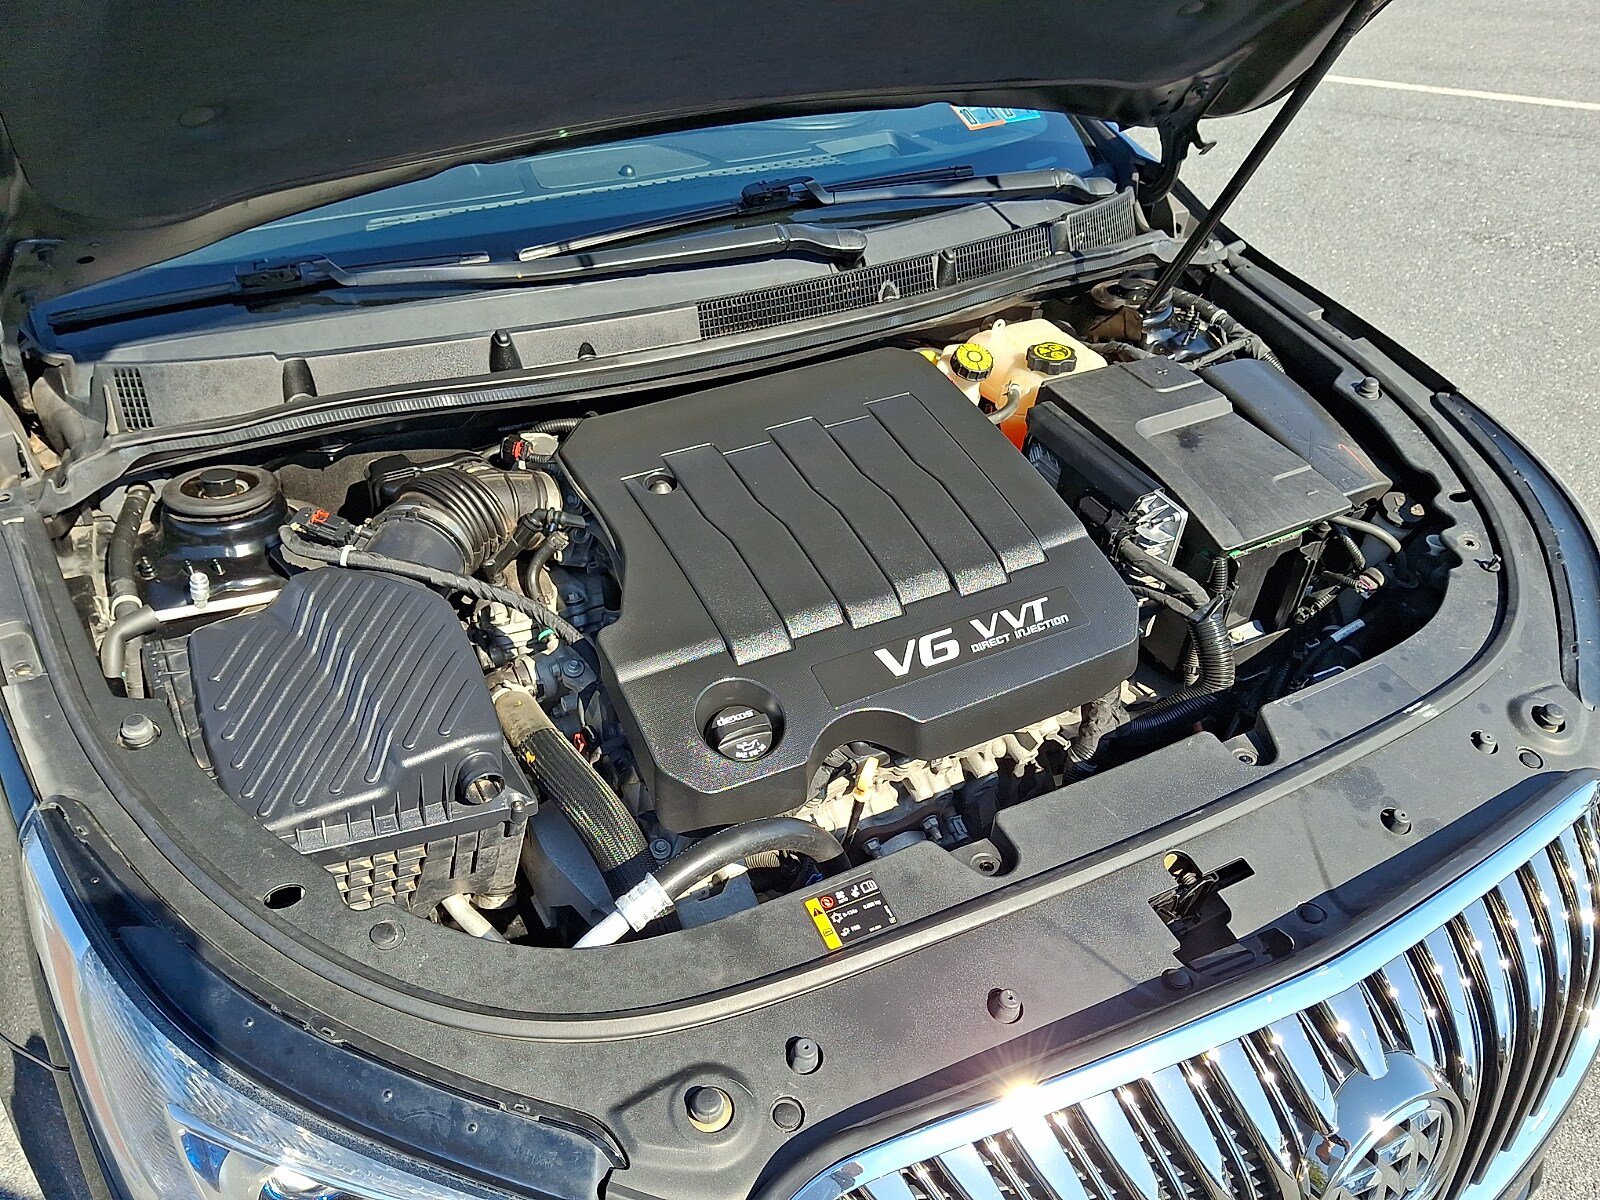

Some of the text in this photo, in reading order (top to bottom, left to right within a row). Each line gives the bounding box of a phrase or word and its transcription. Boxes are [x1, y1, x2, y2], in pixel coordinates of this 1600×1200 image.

[873, 596, 1049, 677] V6 VVT
[970, 613, 1070, 653] DIRECT INJECTION
[716, 710, 754, 726] dexos
